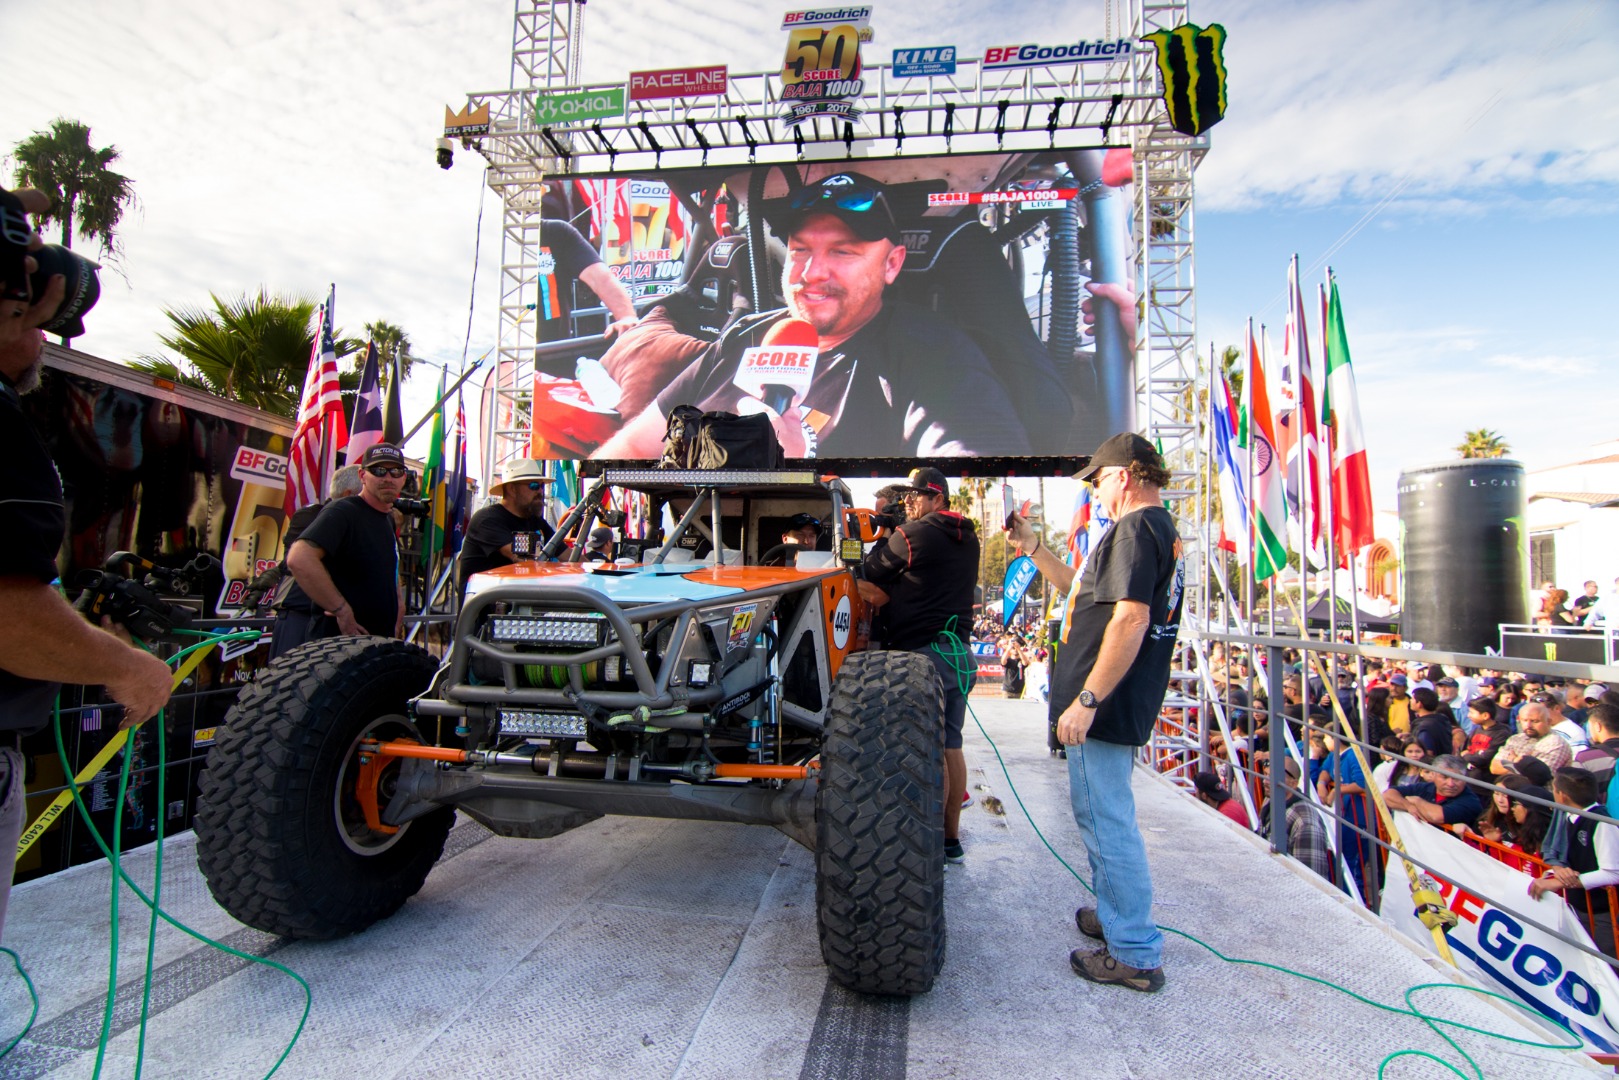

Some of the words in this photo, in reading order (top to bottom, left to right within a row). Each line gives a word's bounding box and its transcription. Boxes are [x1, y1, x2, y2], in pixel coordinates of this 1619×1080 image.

[784, 7, 869, 23] BFGoodrich
[895, 48, 954, 64] KING
[984, 38, 1132, 64] BFGoodrich
[632, 70, 726, 89] RACELINE
[803, 69, 841, 81] SCORE
[684, 83, 726, 93] WHEELS
[783, 83, 822, 99] BAJA
[825, 80, 861, 97] 1000
[794, 104, 817, 116] 1967
[826, 102, 850, 113] 2017
[929, 193, 969, 203] SCORE
[981, 190, 1059, 203] #BAJA1000
[1031, 200, 1055, 208] LIVE
[632, 249, 671, 261] SCORE
[746, 351, 811, 368] SCORE
[681, 537, 697, 545] OMP
[1007, 561, 1031, 597] KING
[834, 611, 850, 632] 4454
[721, 691, 751, 711] ANTIROCK
[39, 804, 63, 822] WLL
[19, 823, 45, 845] 6400
